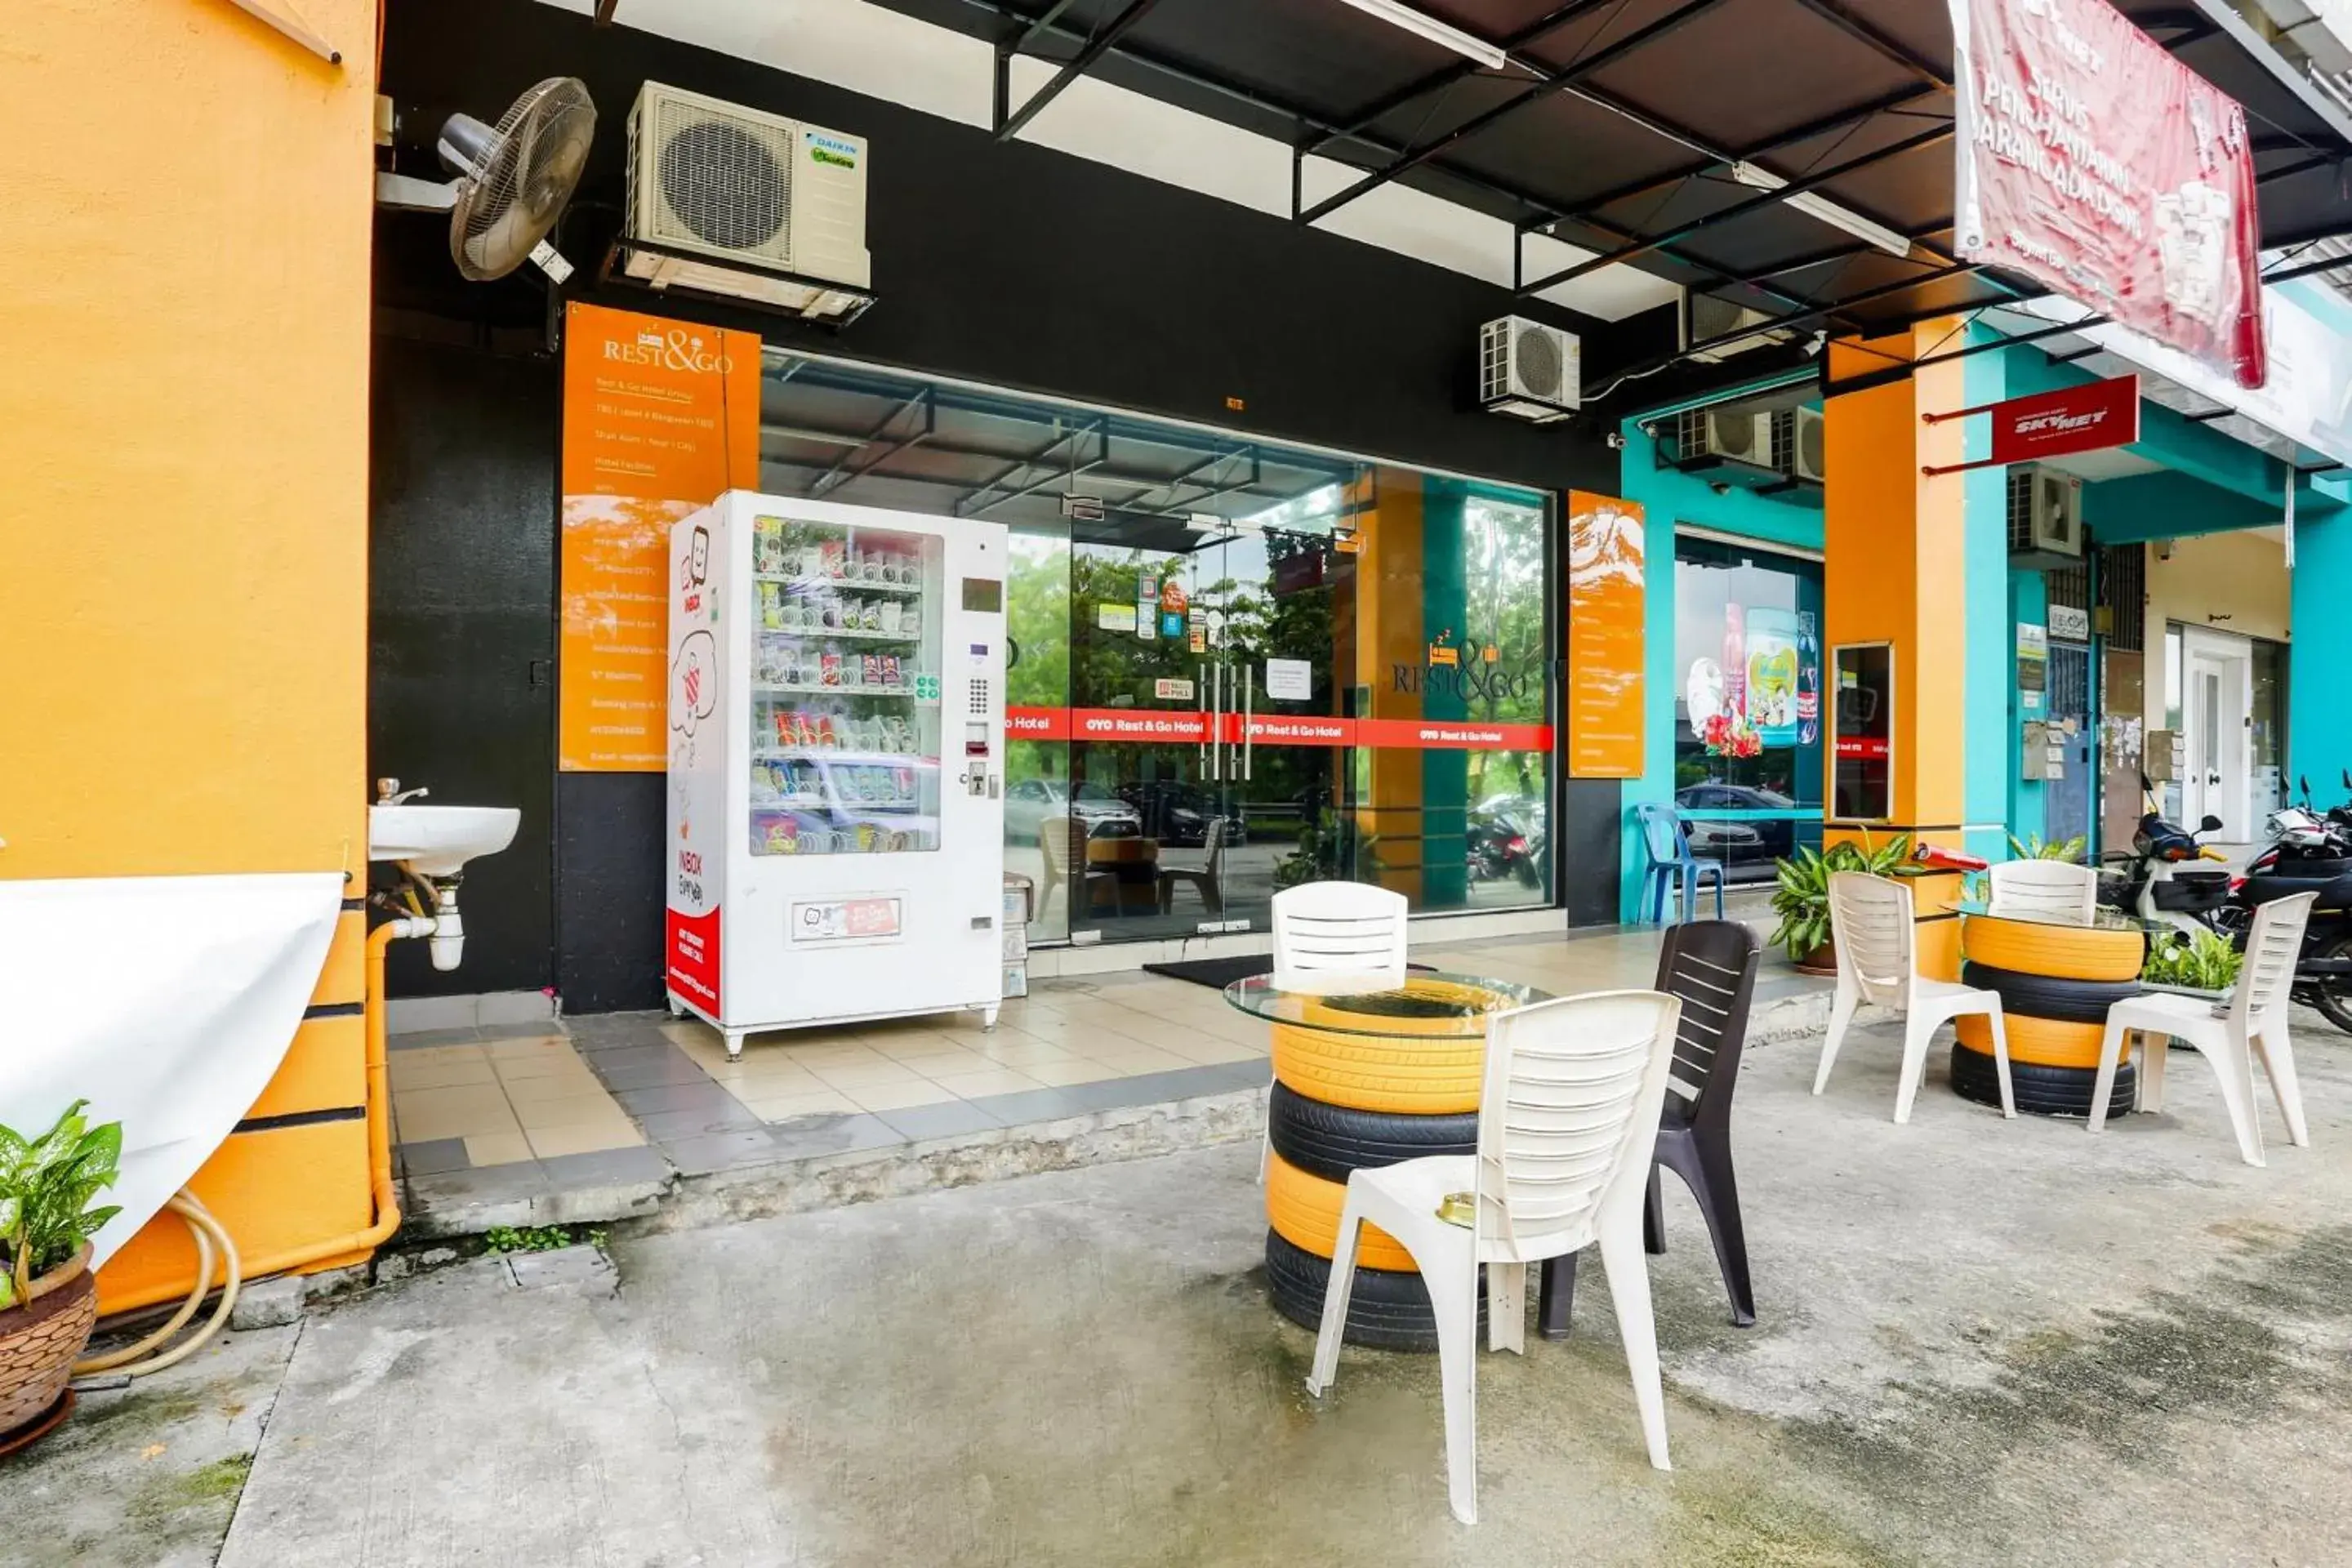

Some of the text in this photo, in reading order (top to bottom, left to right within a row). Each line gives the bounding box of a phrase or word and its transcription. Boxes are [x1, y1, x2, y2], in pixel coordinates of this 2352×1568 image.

[817, 138, 857, 154] DAIKIN
[1015, 716, 1049, 729] Hotel
[1086, 718, 1204, 733] OYO Rest & Go Hotel
[1266, 724, 1290, 736] Rest
[1291, 724, 1298, 736] &
[1300, 725, 1315, 737] Go
[1316, 726, 1342, 737] Hotel
